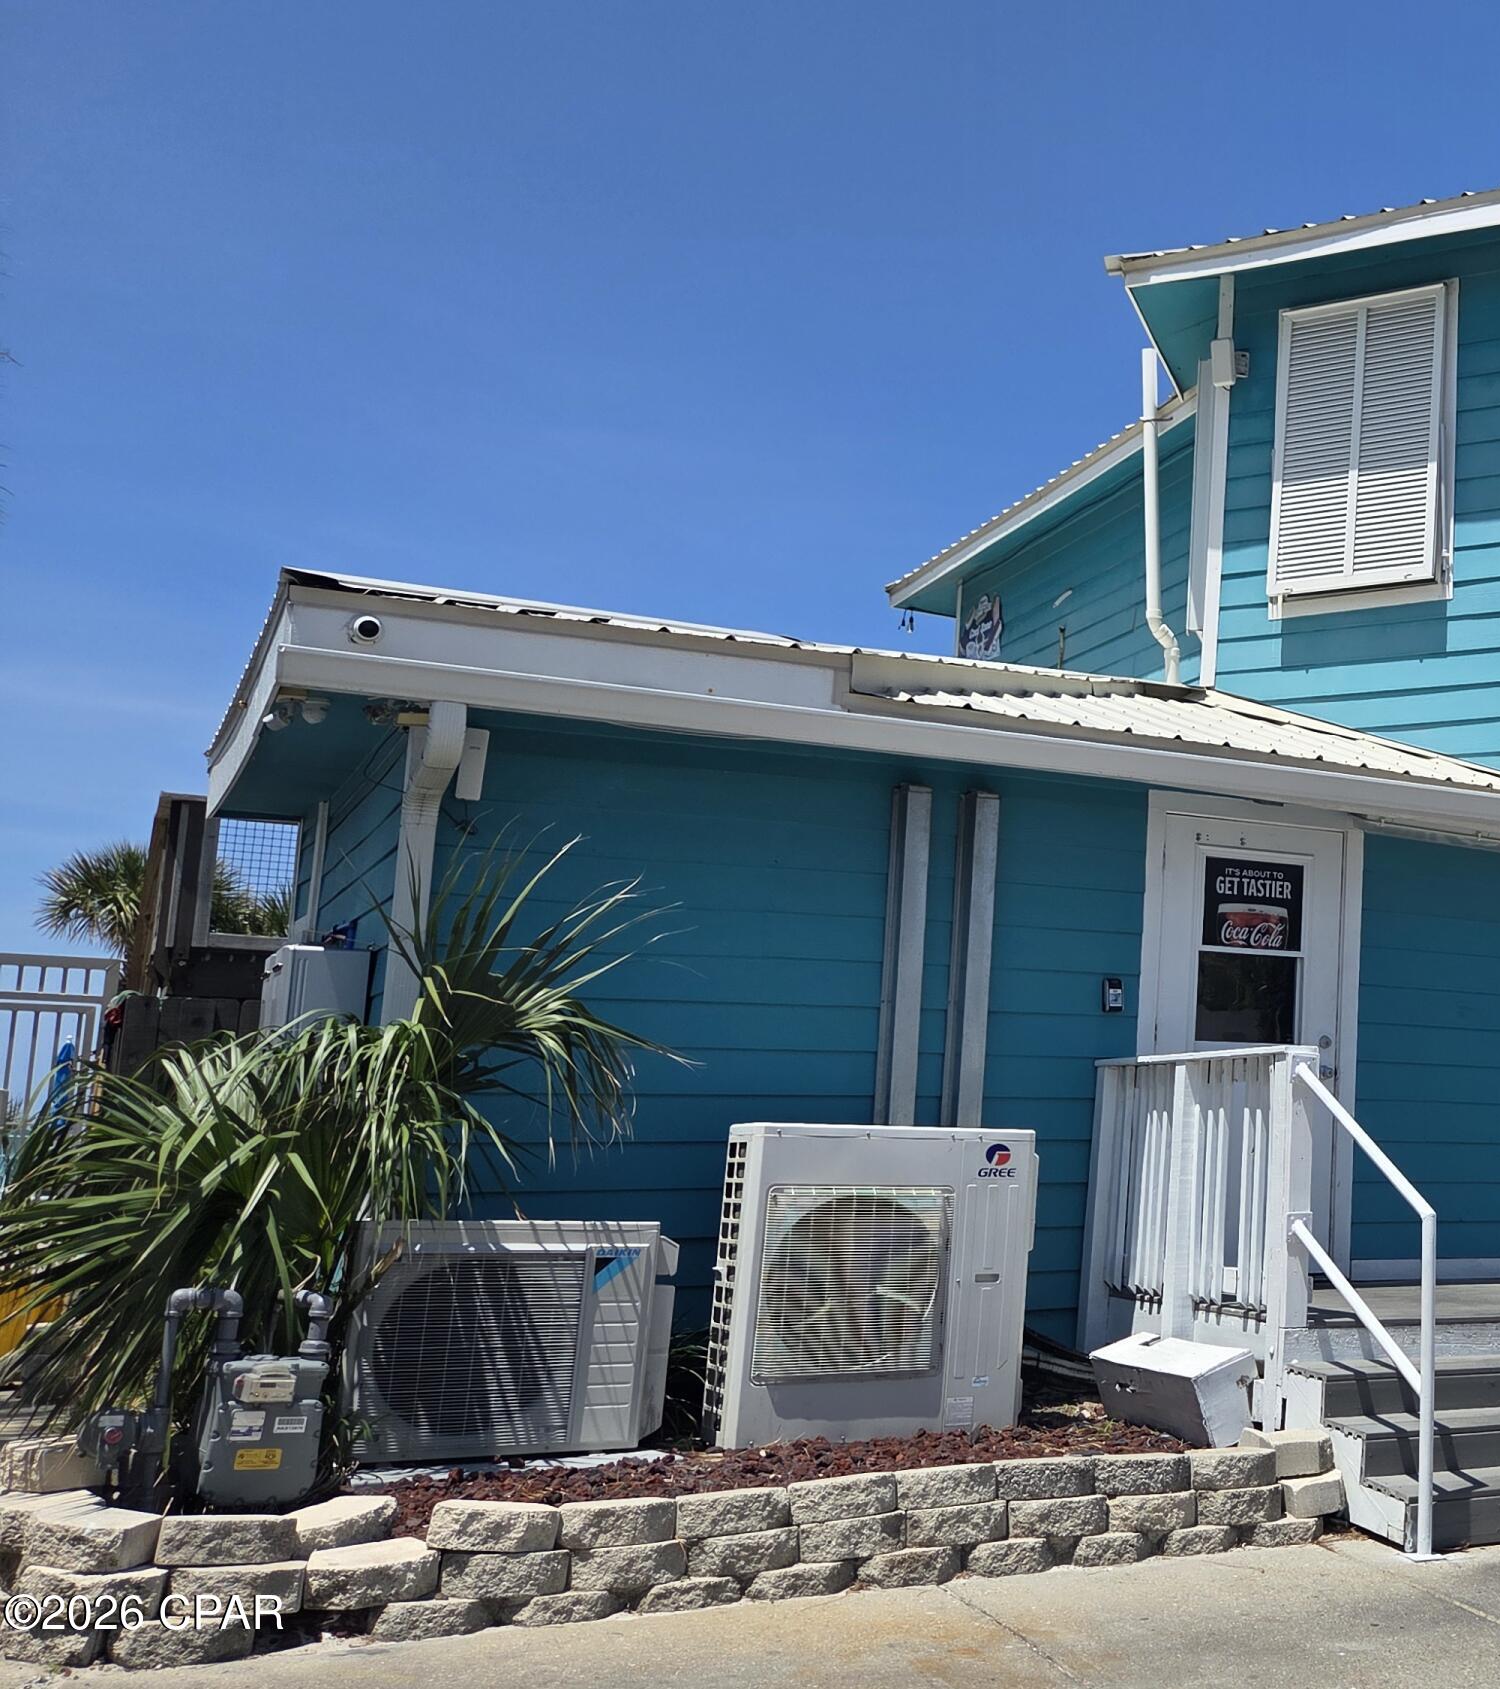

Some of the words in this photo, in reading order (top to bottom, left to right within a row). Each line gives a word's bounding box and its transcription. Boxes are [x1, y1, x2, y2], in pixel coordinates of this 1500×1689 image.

[1225, 867, 1241, 876] IT'S
[1242, 869, 1272, 878] ABOUT
[1273, 871, 1284, 880] TO
[1216, 876, 1241, 896] GET
[1242, 878, 1292, 899] TASTIER
[1221, 920, 1286, 948] Coca-Cola
[977, 1167, 1017, 1178] GREE
[596, 1248, 642, 1257] DAIKIN
